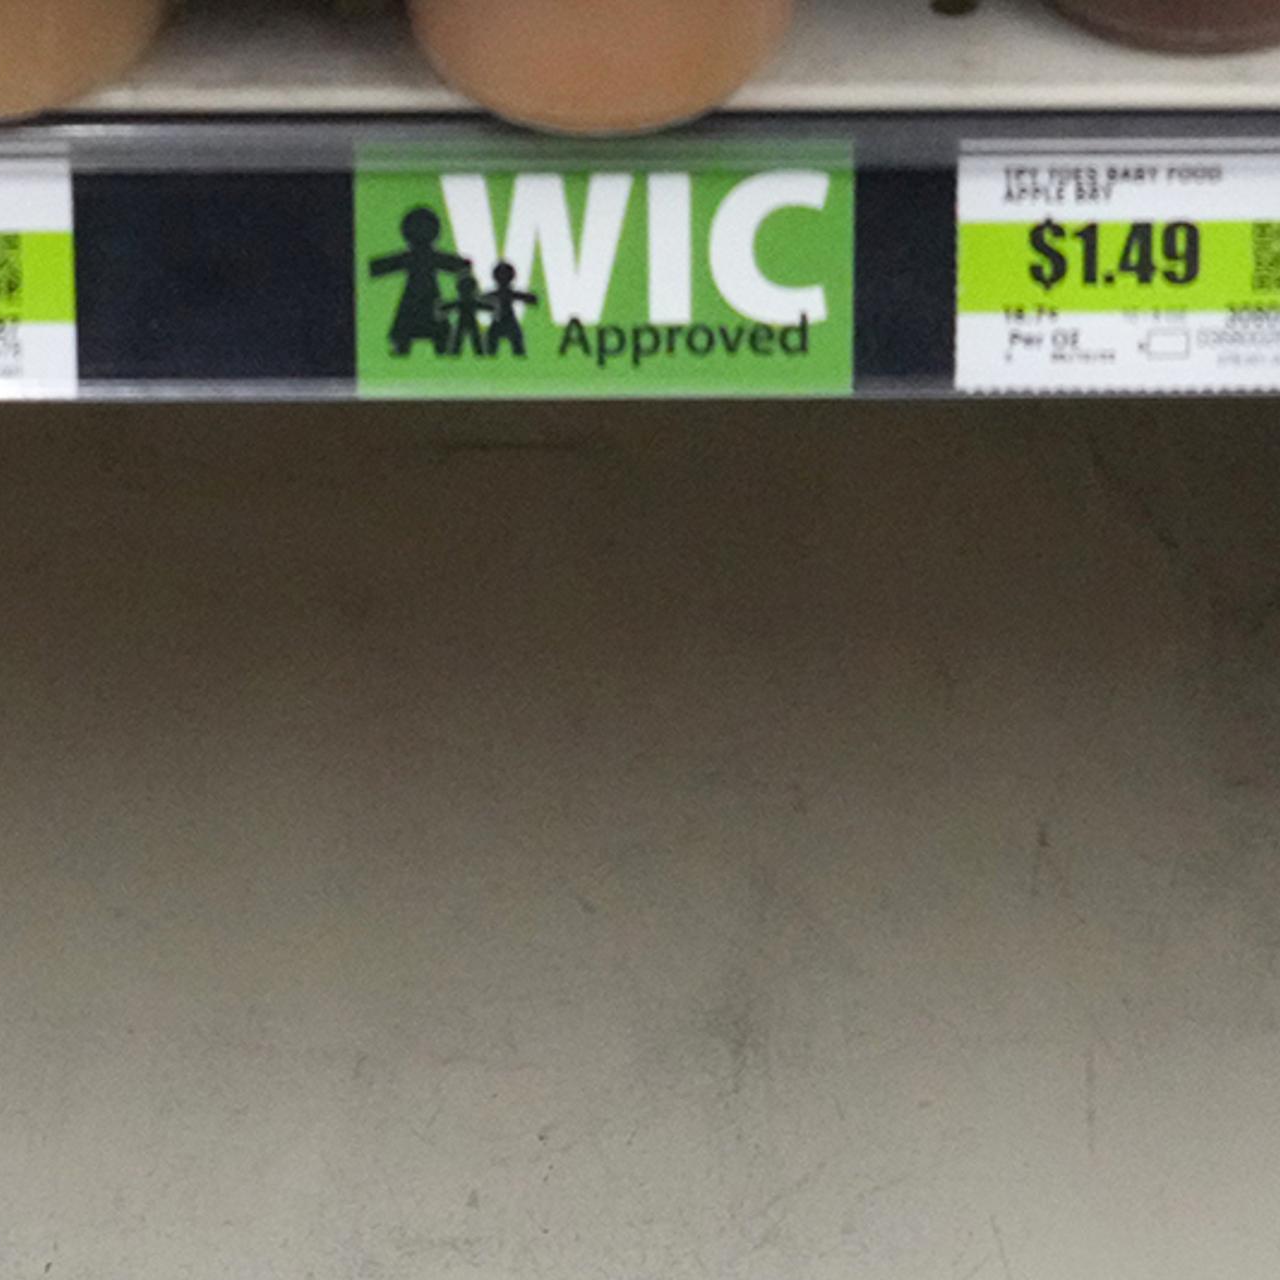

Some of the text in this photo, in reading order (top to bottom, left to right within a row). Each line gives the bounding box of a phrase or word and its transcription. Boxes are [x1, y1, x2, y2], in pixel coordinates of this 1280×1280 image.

[1107, 165, 1158, 182] BABY
[1168, 165, 1223, 182] FOOD
[1004, 183, 1064, 201] APPLE
[440, 170, 830, 327] WIC
[1028, 218, 1200, 292] $1.49
[559, 313, 808, 366] Approved
[1052, 328, 1080, 347] OZ
